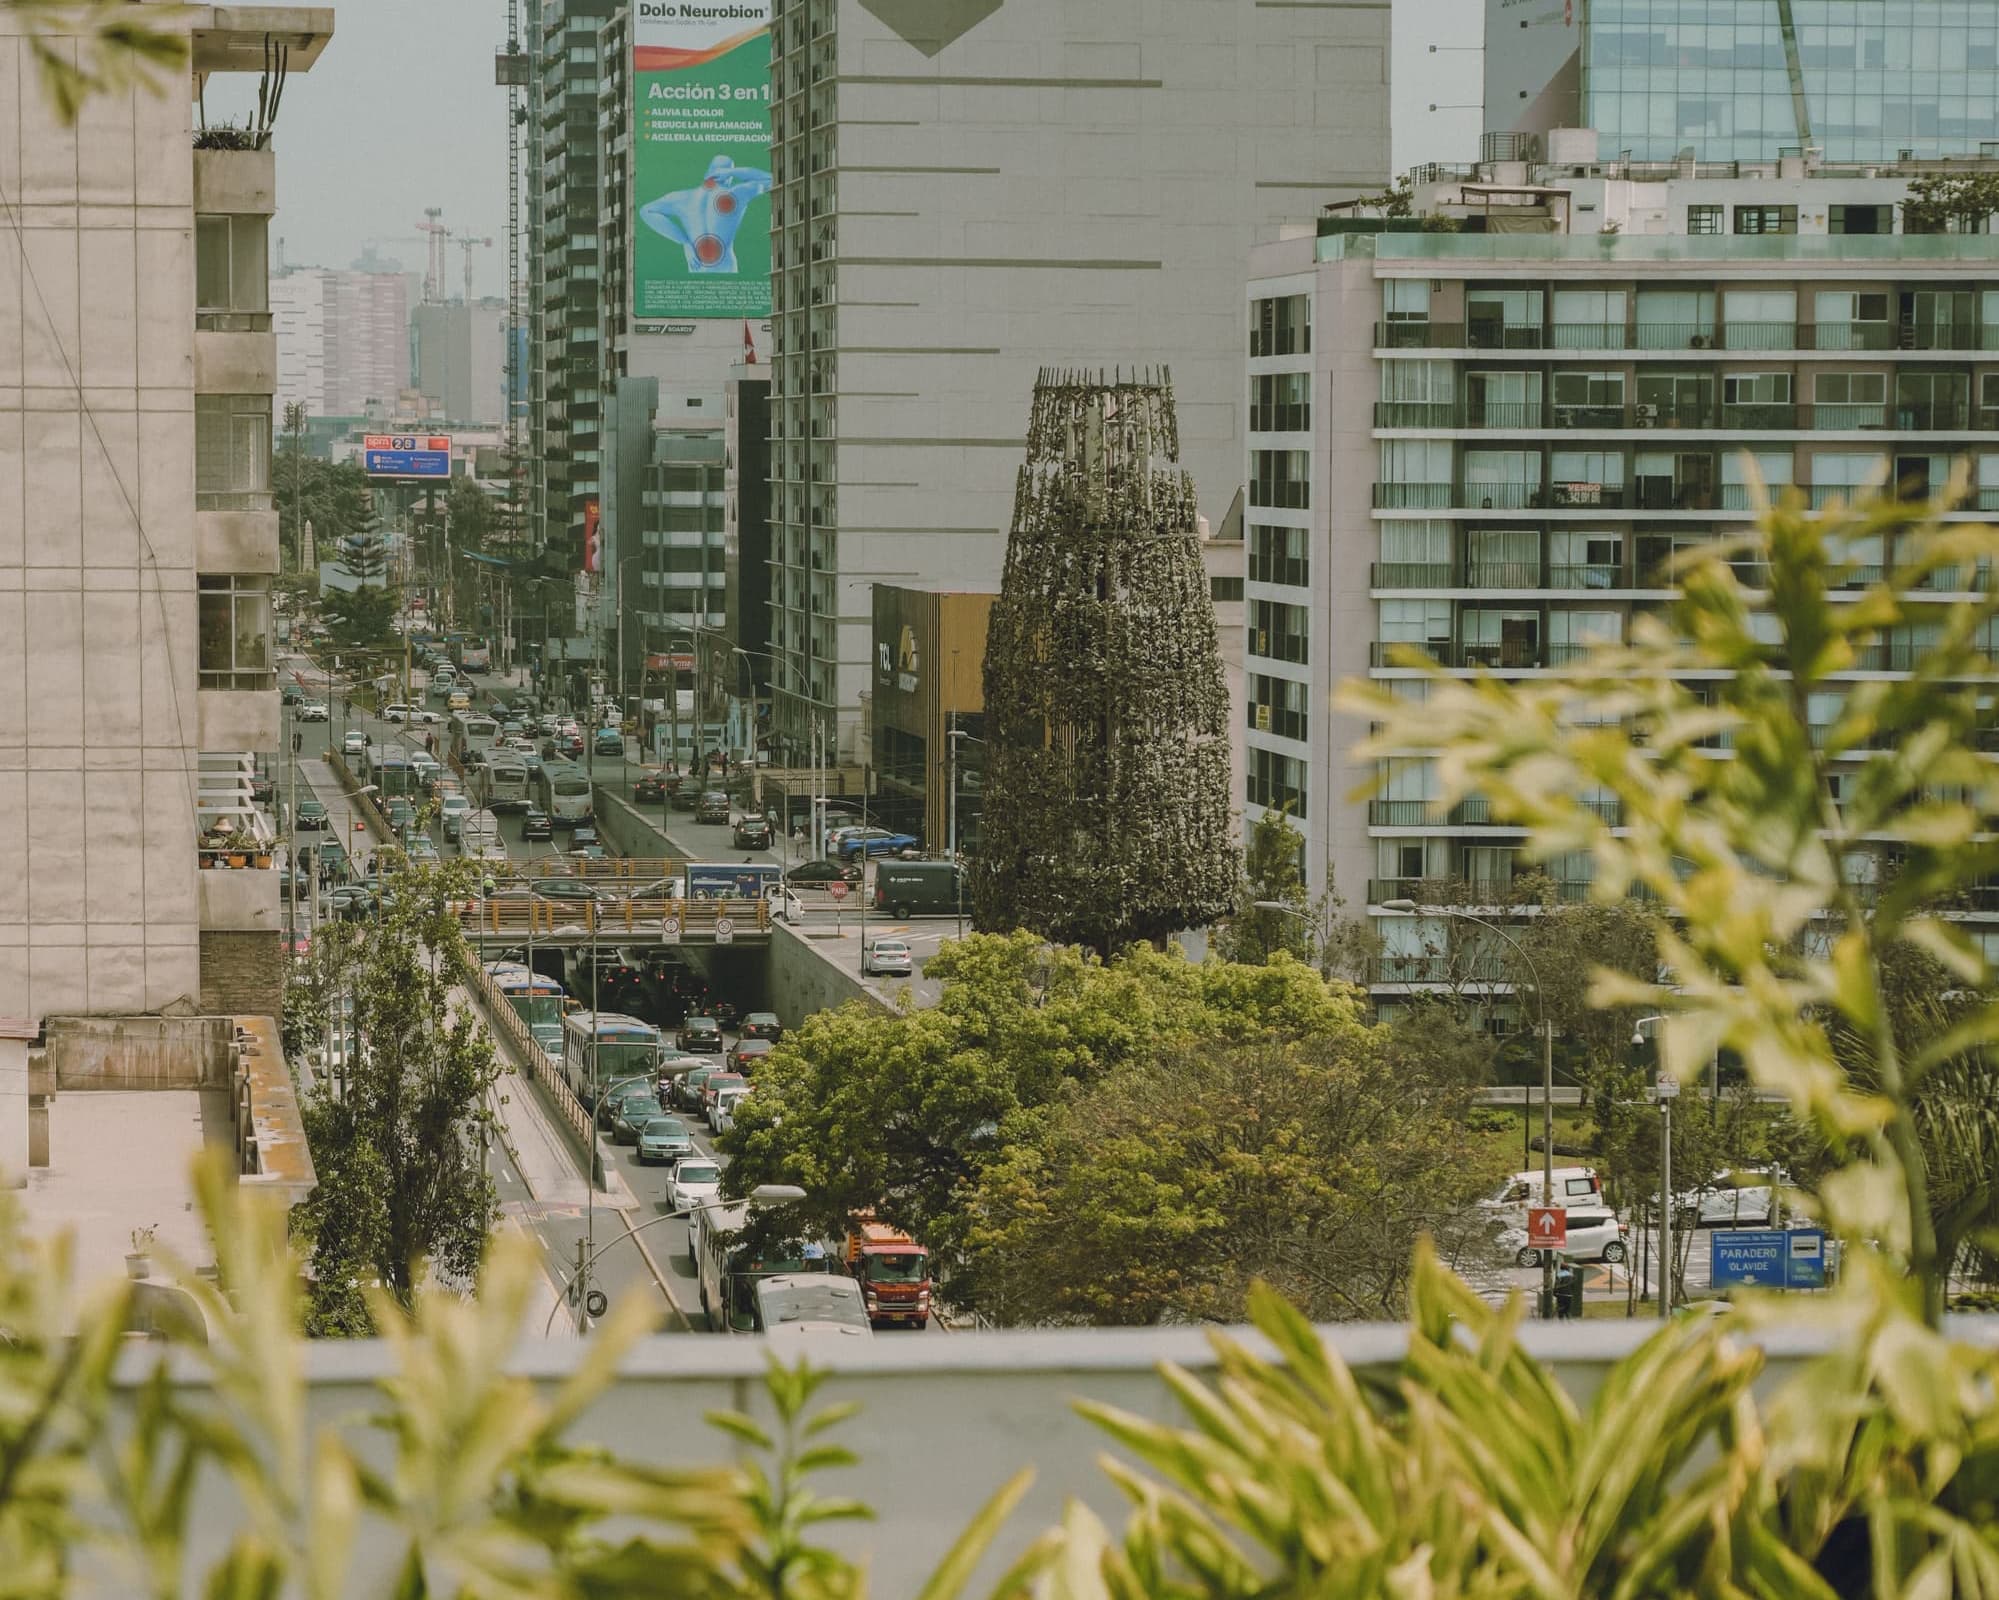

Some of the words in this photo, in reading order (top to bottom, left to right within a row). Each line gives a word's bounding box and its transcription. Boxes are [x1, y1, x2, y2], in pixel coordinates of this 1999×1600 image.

[640, 3, 676, 17] Dolo
[680, 4, 764, 18] Neurobion
[648, 82, 715, 100] Acción
[719, 84, 731, 100] 3
[735, 87, 757, 100] en
[761, 84, 770, 99] 1
[651, 108, 680, 117] ALIVIA
[682, 109, 693, 117] EL
[694, 109, 724, 117] DOLOR
[651, 120, 686, 129] REDUCE
[688, 121, 699, 129] LA
[701, 119, 762, 130] INFLAMACIÓN
[651, 131, 692, 141] ACELERA
[693, 133, 704, 142] LA
[1720, 1248, 1777, 1259] PARADERO
